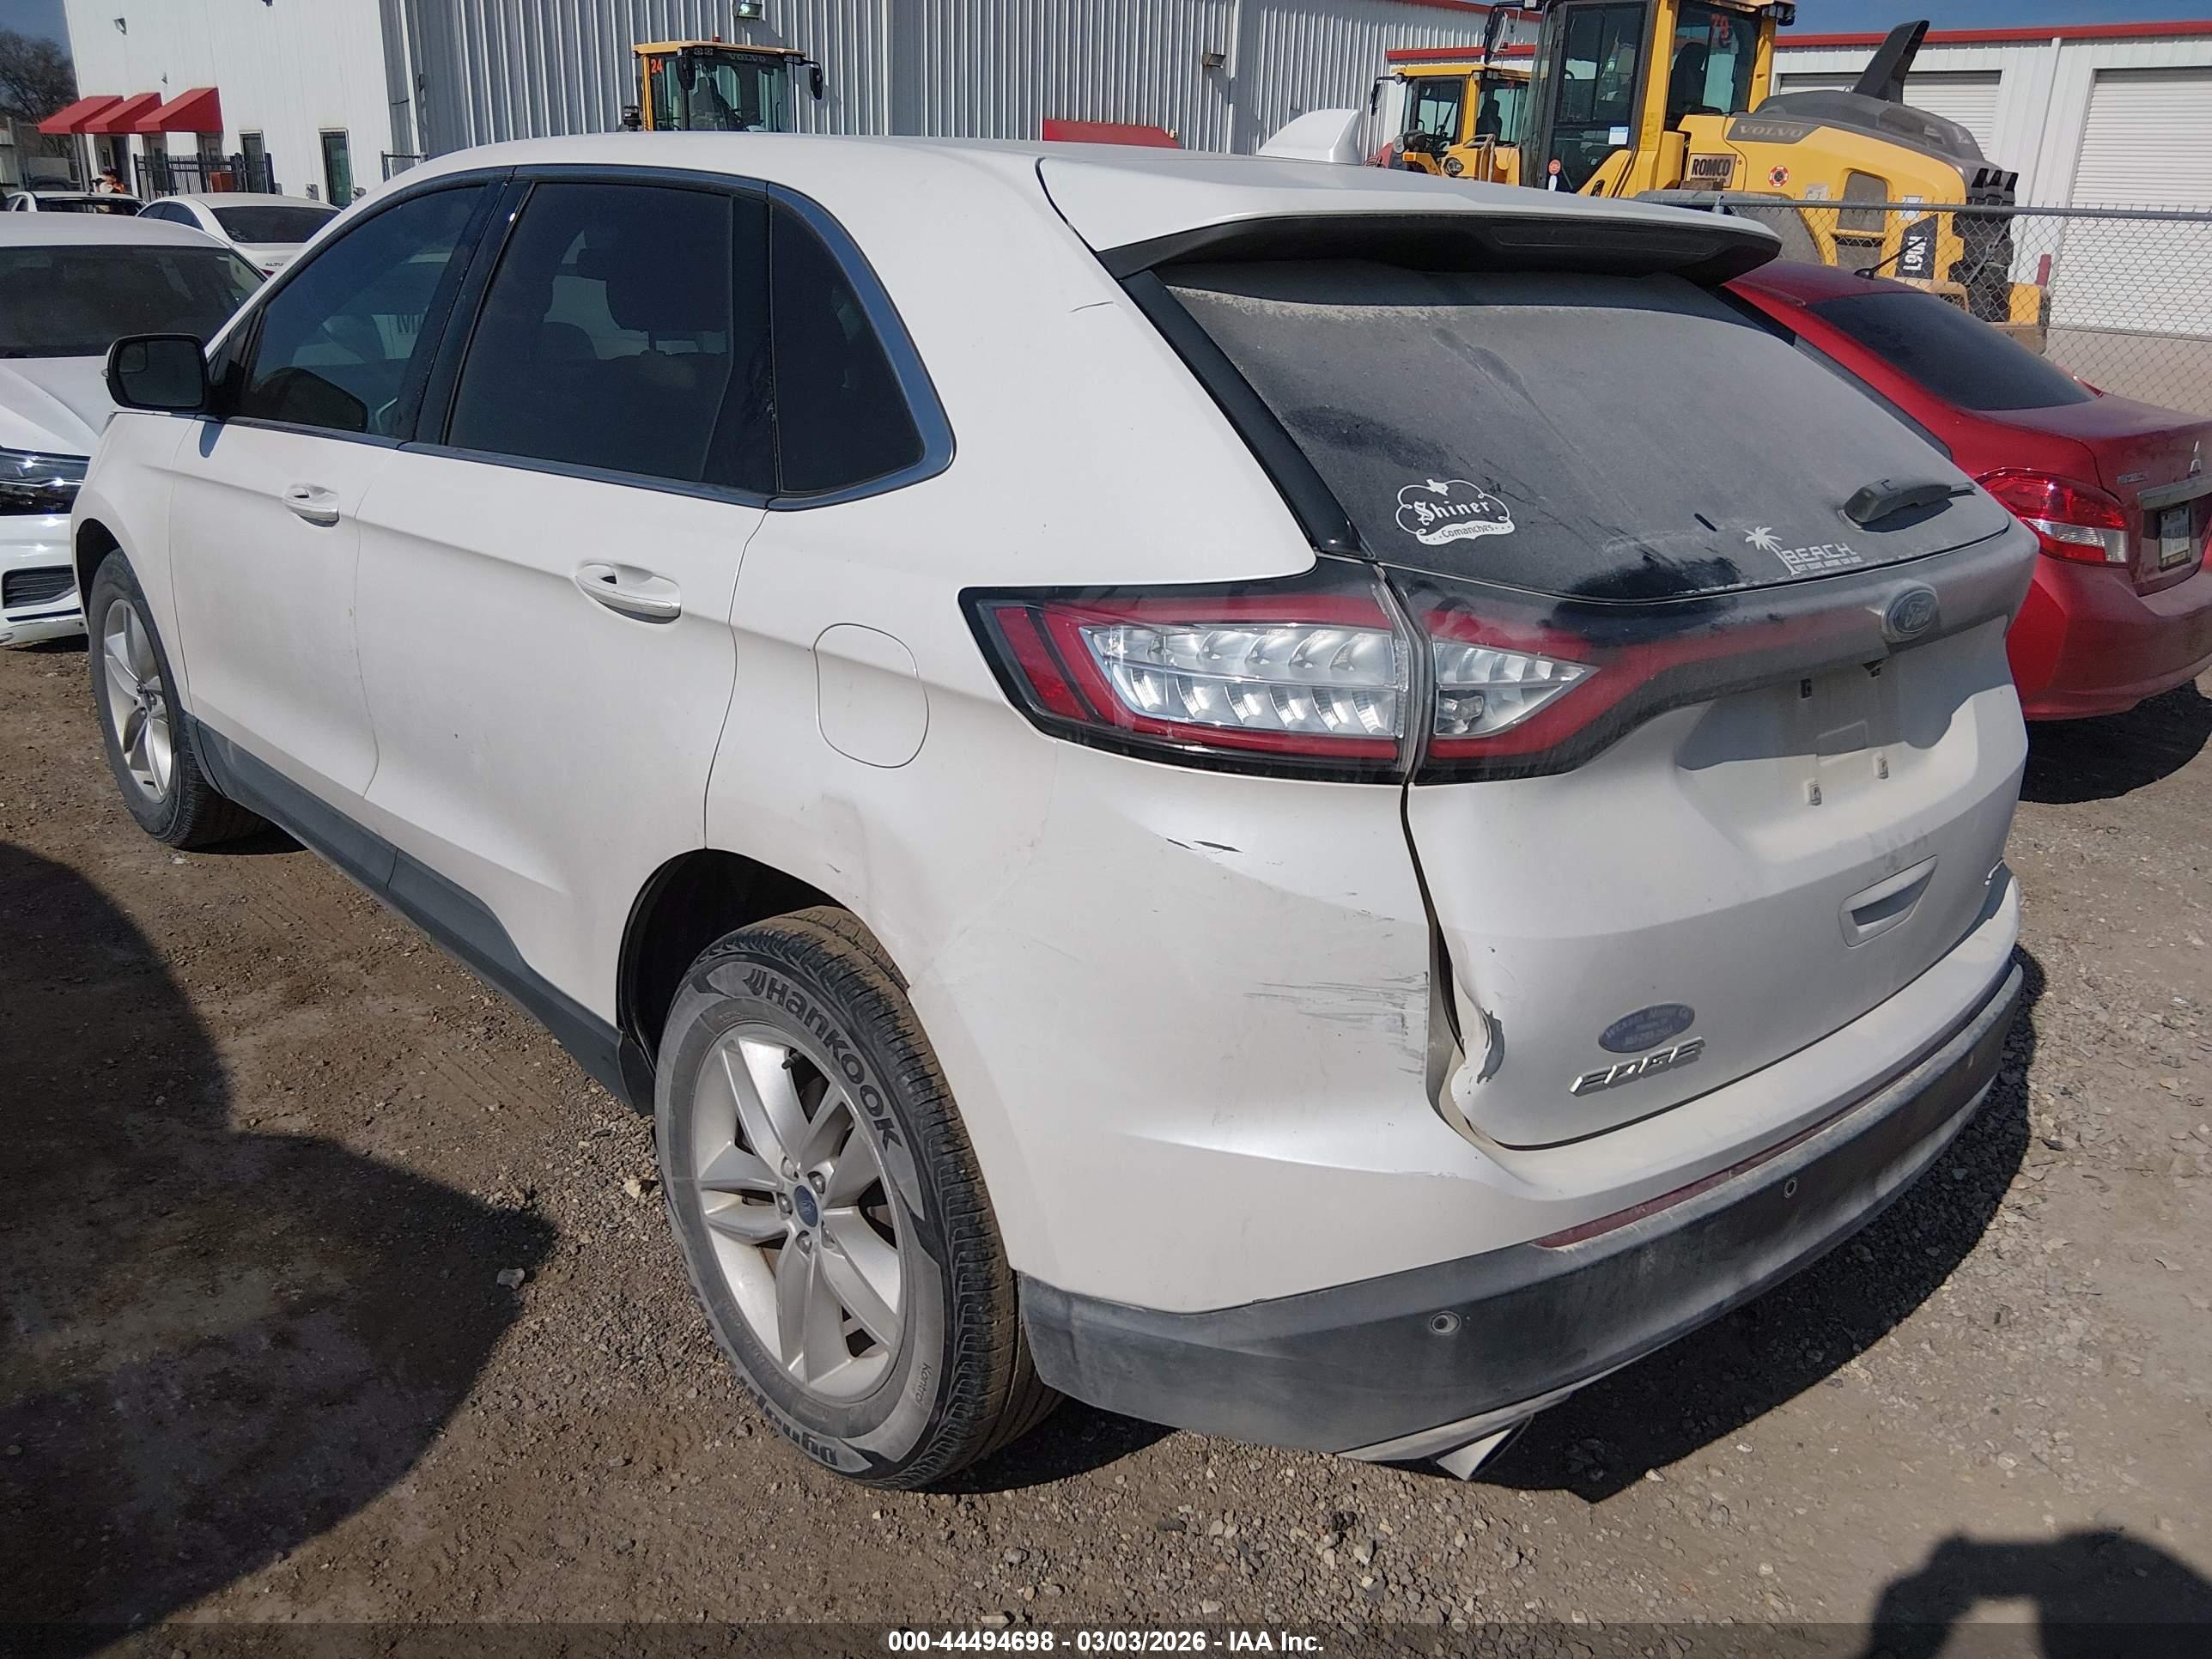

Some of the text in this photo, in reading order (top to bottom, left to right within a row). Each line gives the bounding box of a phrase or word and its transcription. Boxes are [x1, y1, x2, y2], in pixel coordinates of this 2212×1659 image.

[650, 58, 664, 74] 24
[730, 52, 767, 63] VOLVO
[1739, 125, 1804, 137] VOLVO
[1691, 158, 1731, 177] ROMCO
[1413, 501, 1491, 526] Shiner
[1441, 524, 1495, 538] Comanches
[1781, 542, 1857, 564] BEACH
[1570, 1036, 1705, 1097] EDGE
